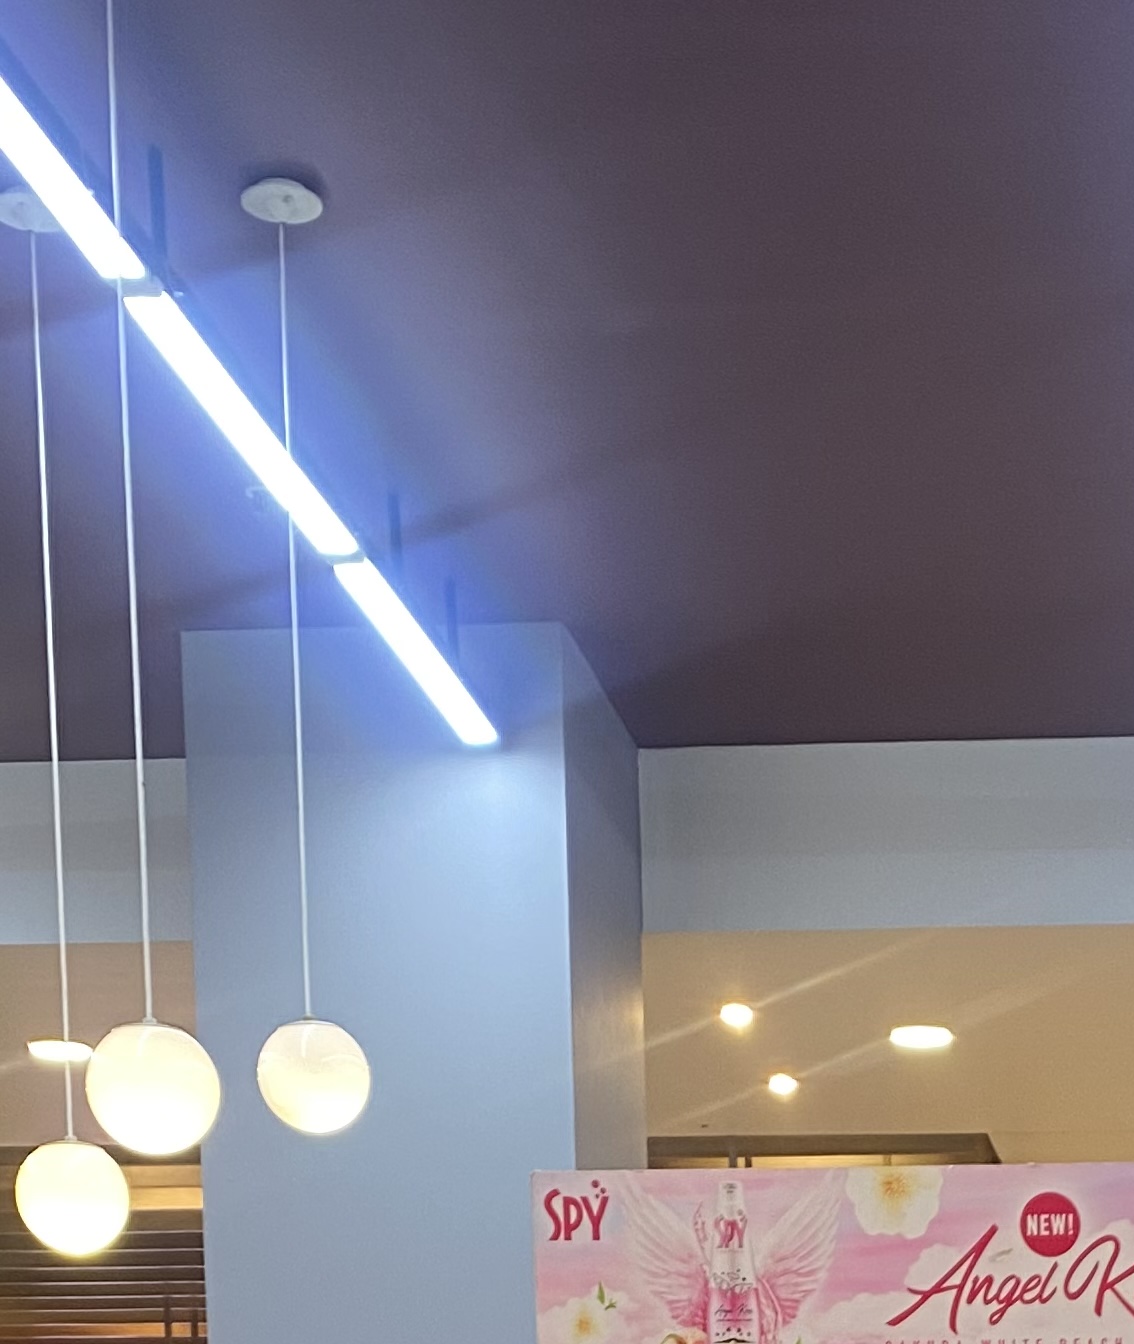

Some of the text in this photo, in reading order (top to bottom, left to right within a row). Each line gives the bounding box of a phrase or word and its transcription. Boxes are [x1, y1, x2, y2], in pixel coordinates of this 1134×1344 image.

[544, 1180, 610, 1242] SPY
[1026, 1211, 1075, 1237] NEW!
[885, 1224, 1058, 1333] Angel
